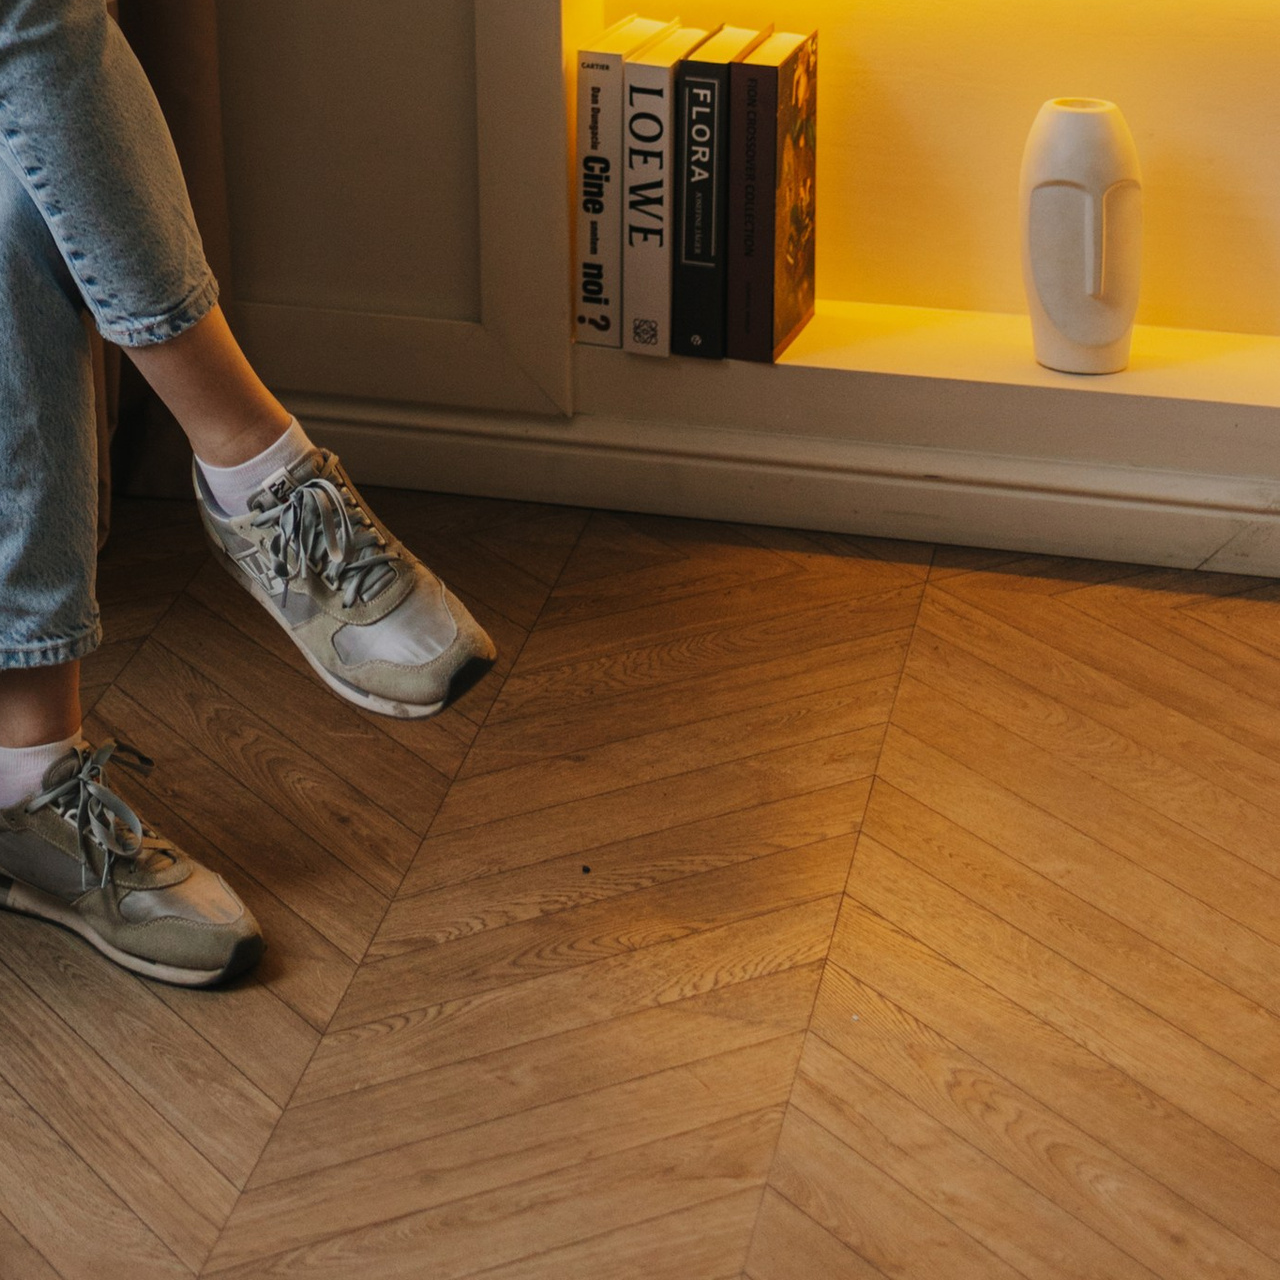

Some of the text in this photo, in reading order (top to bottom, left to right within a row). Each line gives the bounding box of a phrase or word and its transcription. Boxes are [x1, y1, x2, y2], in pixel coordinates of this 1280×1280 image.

[581, 61, 611, 72] CARTIER
[591, 86, 601, 105] Dan
[628, 84, 664, 248] LOEWE
[691, 88, 711, 183] FLORA
[745, 110, 757, 181] CROSSOVER
[582, 155, 611, 215] Cine
[744, 184, 755, 257] COLLECTION
[582, 262, 610, 306] noi
